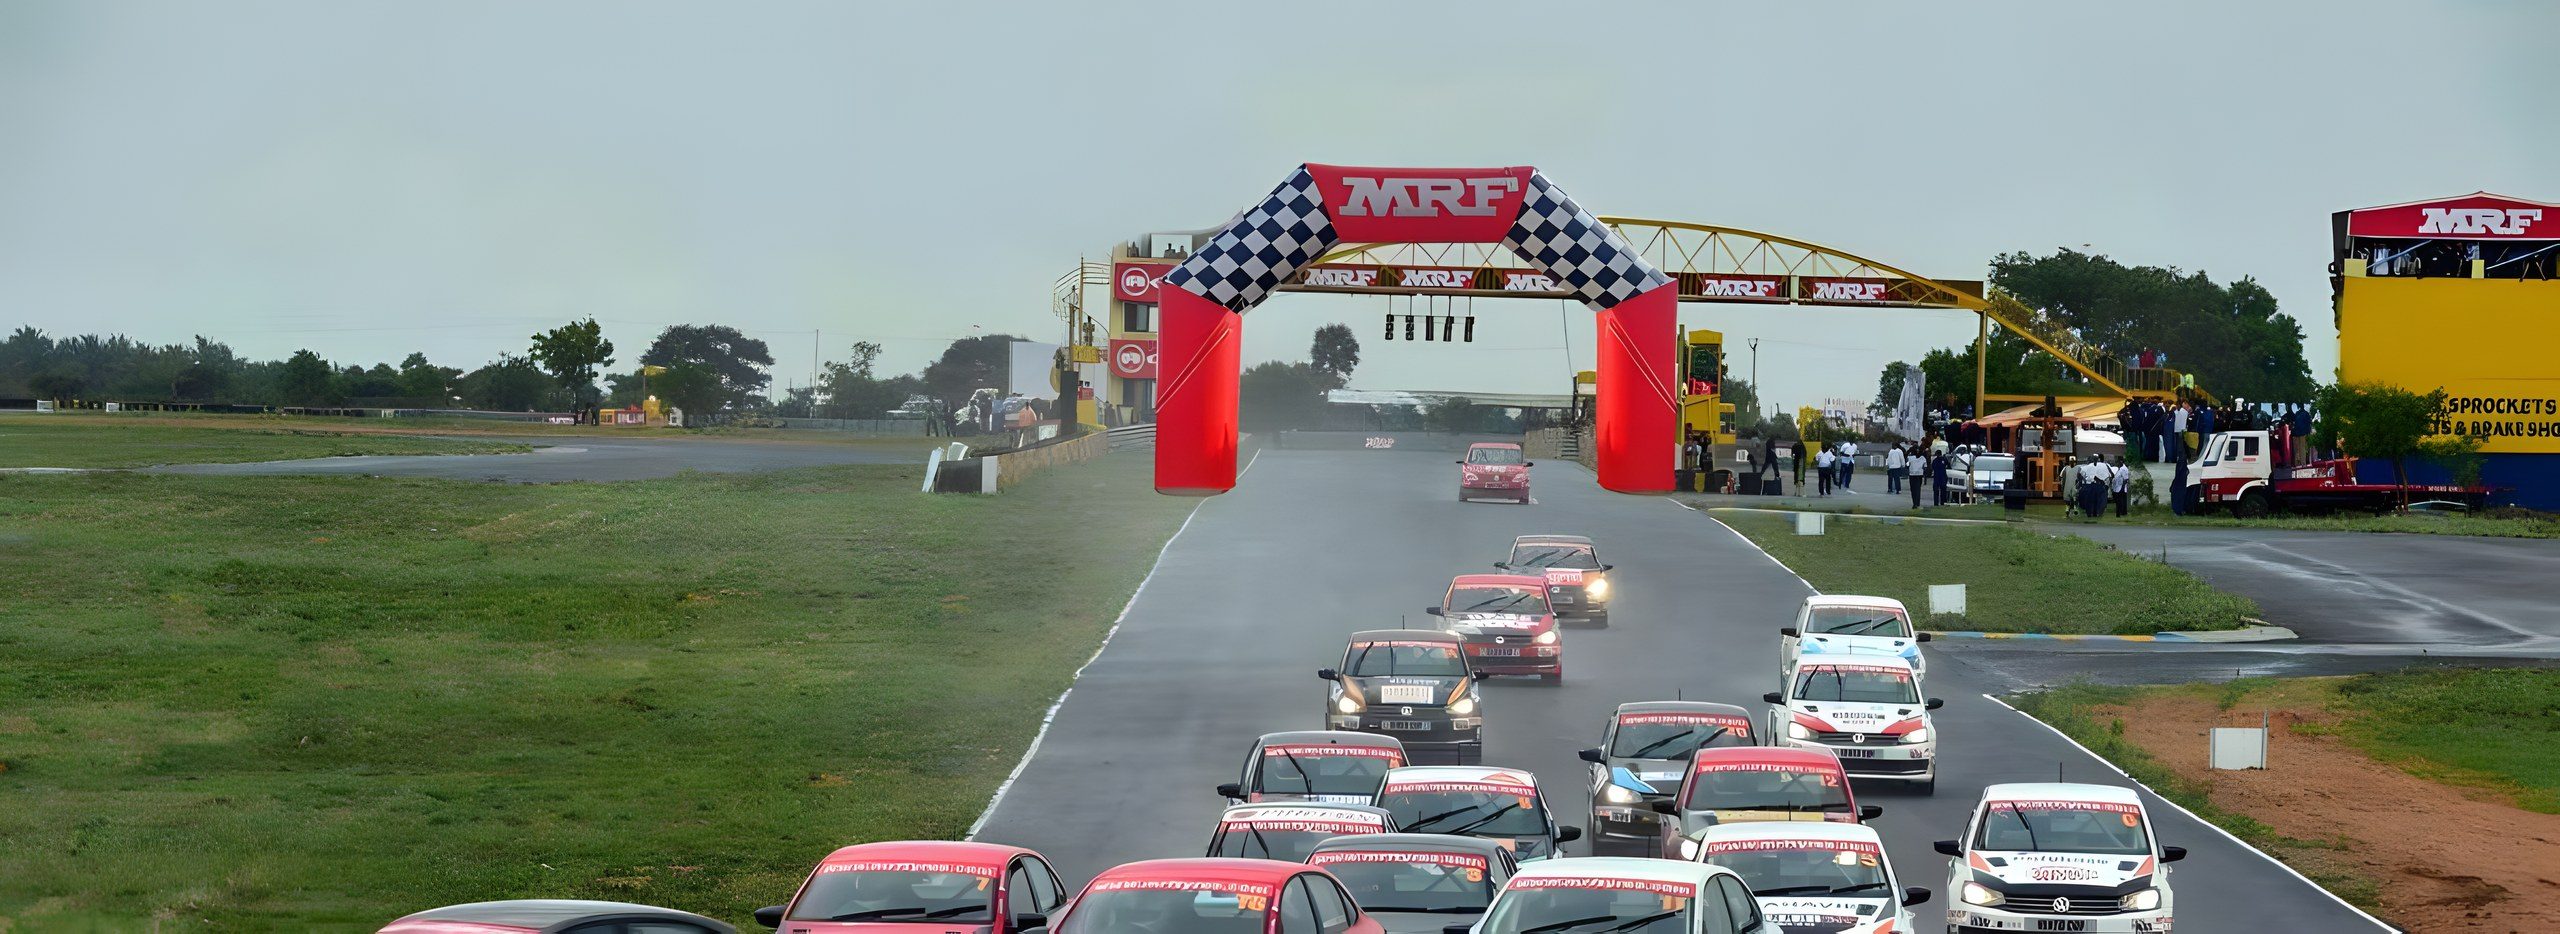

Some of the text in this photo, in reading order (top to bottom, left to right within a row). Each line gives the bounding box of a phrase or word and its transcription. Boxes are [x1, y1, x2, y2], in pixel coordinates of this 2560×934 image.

[1339, 176, 1519, 217] MRF
[2418, 208, 2542, 234] MRF
[1304, 268, 1377, 286] MRF
[1401, 269, 1474, 287] MRF
[1505, 273, 1565, 292] MR
[1702, 279, 1775, 297] MRF
[1813, 282, 1885, 300] MRF
[2449, 397, 2557, 415] SPROCKETS
